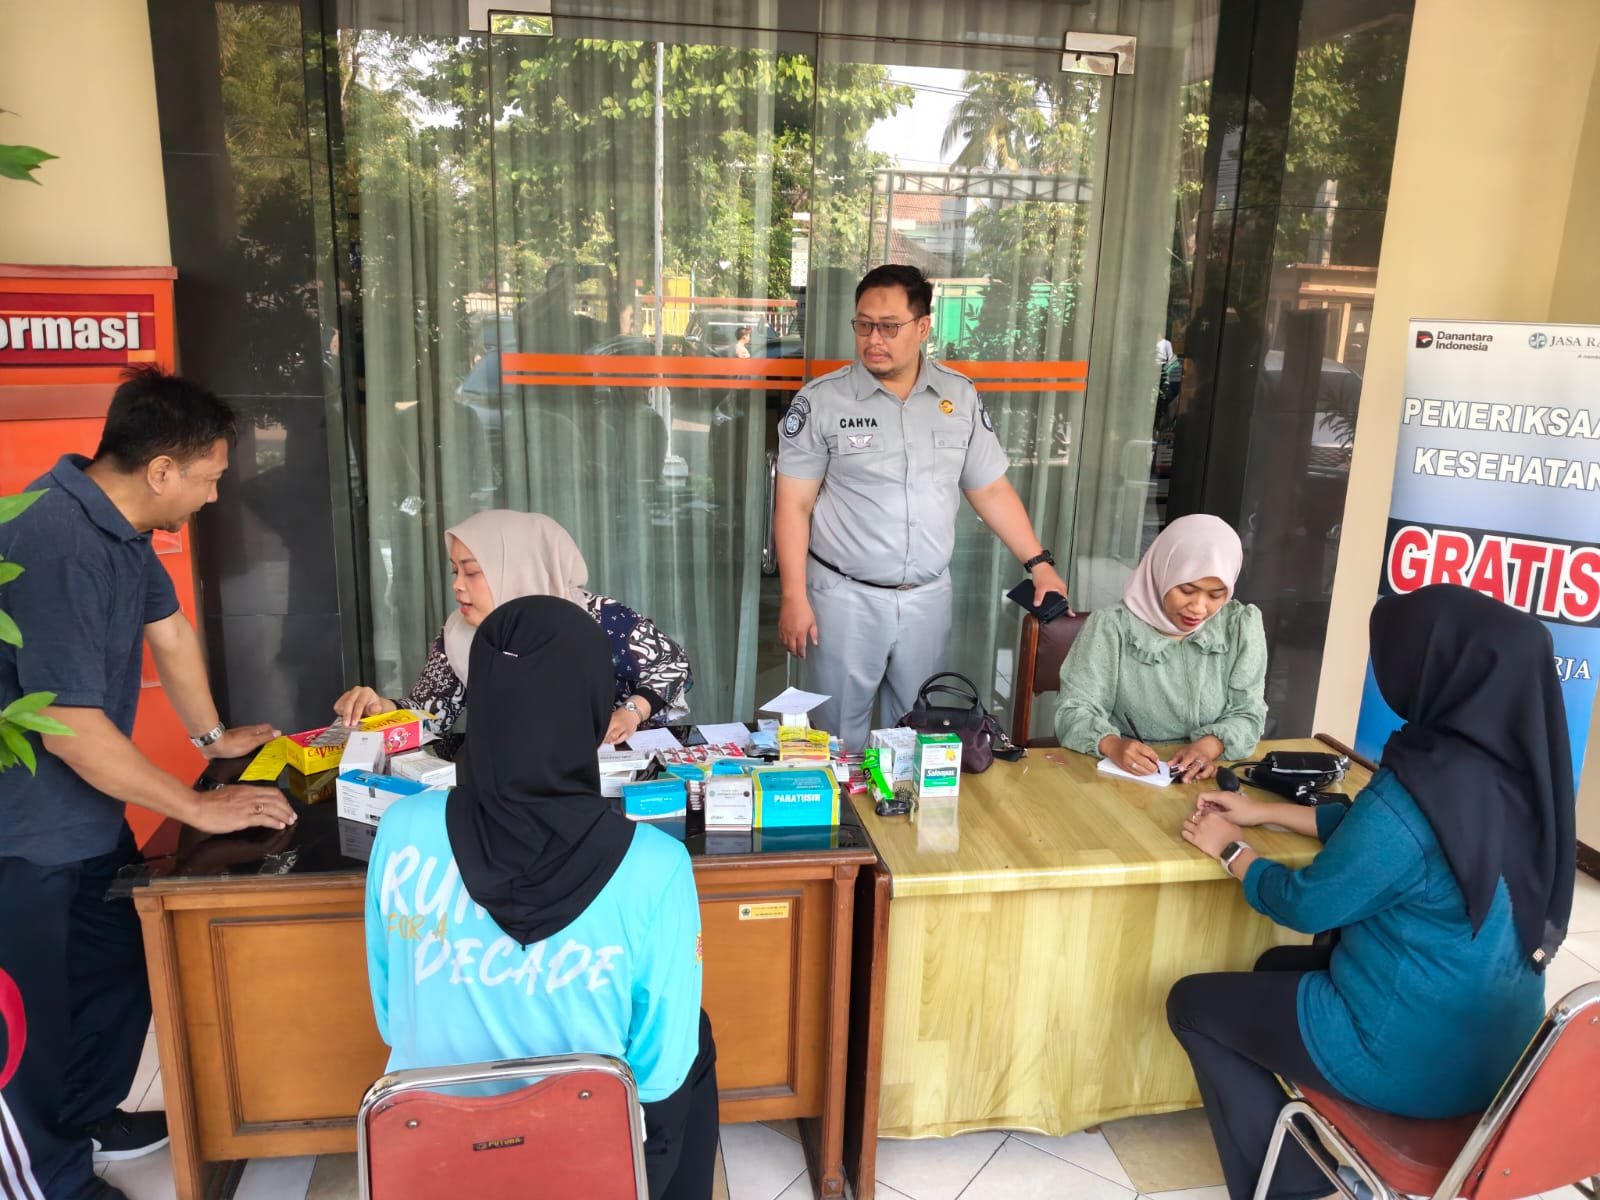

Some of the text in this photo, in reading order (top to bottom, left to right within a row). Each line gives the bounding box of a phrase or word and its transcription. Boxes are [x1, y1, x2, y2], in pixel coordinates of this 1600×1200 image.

[1437, 330, 1494, 342] Danantara
[1549, 335, 1600, 348] JASA R
[1435, 340, 1489, 351] Indonesia
[840, 417, 878, 429] CAHYA
[1387, 525, 1600, 623] GRATIS
[774, 793, 821, 803] PARATUSIN
[387, 911, 449, 947] FOR A
[414, 930, 625, 996] DECADE
